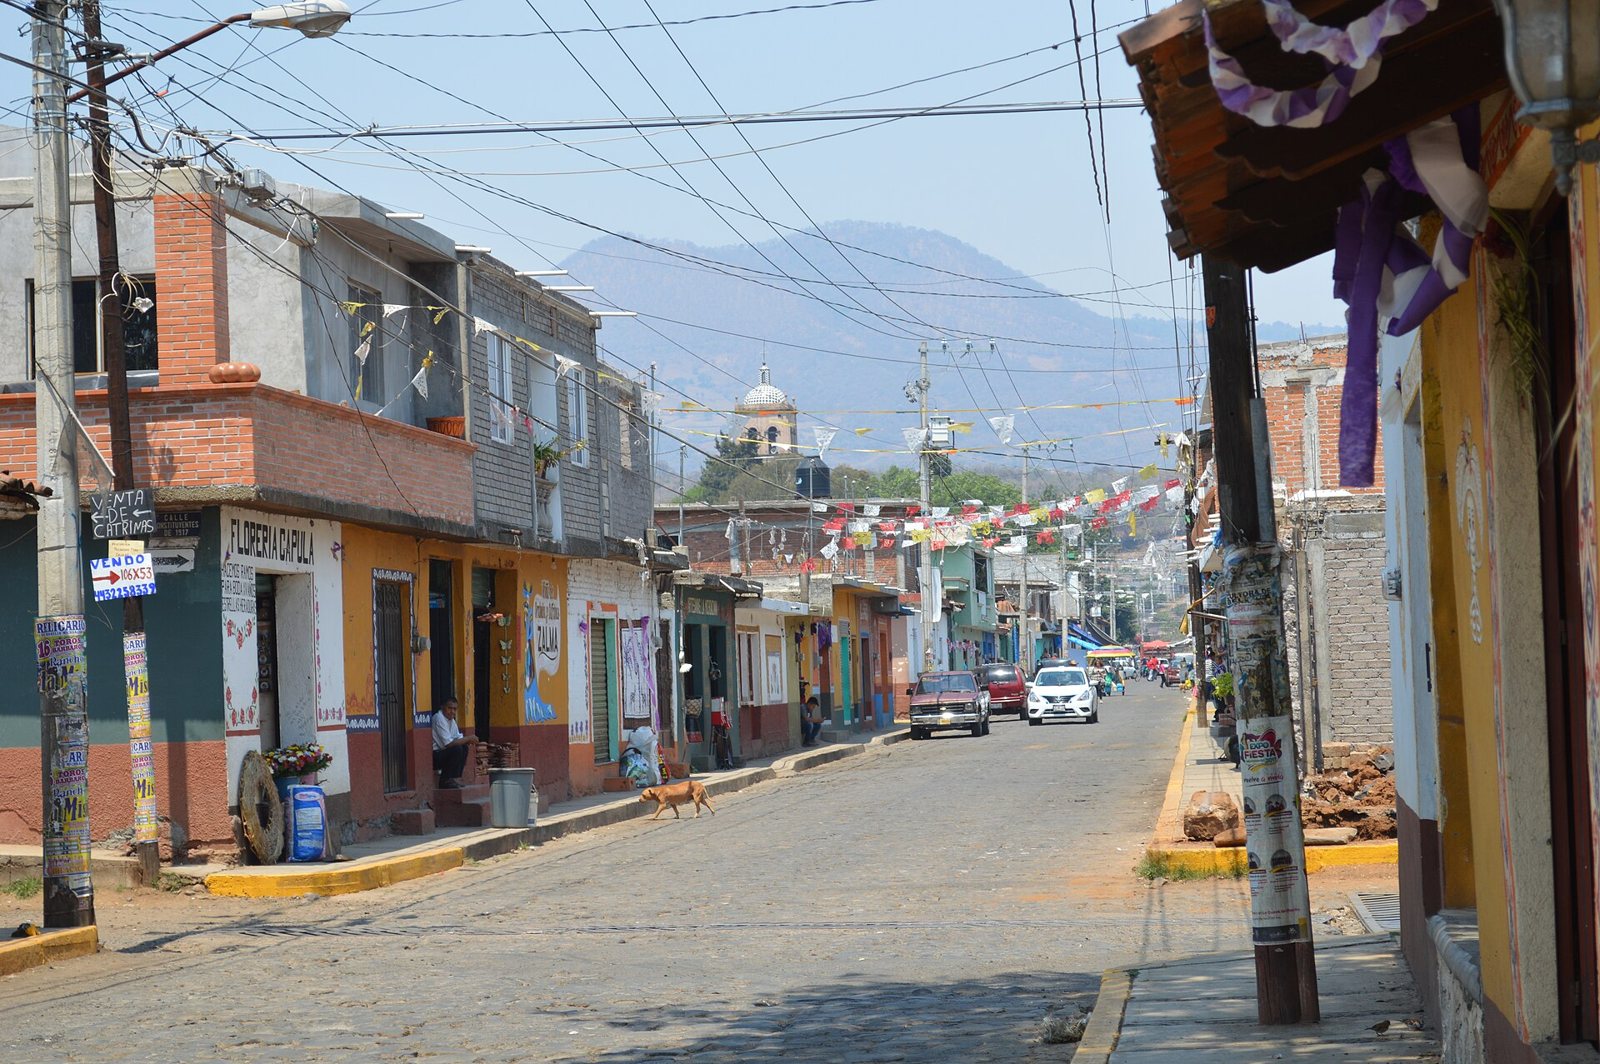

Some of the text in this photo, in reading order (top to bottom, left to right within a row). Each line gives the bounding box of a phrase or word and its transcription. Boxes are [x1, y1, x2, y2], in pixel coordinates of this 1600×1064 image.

[108, 507, 129, 523] DE
[164, 513, 189, 521] CALLE
[93, 519, 154, 538] CATRINAS
[157, 520, 200, 530] ONSTITUYENTES
[164, 528, 190, 537] DE 1917
[230, 518, 315, 565] FLORERIA CAPULA
[90, 553, 145, 570] VENDO
[37, 639, 51, 658] 16
[1249, 742, 1269, 750] EXPO
